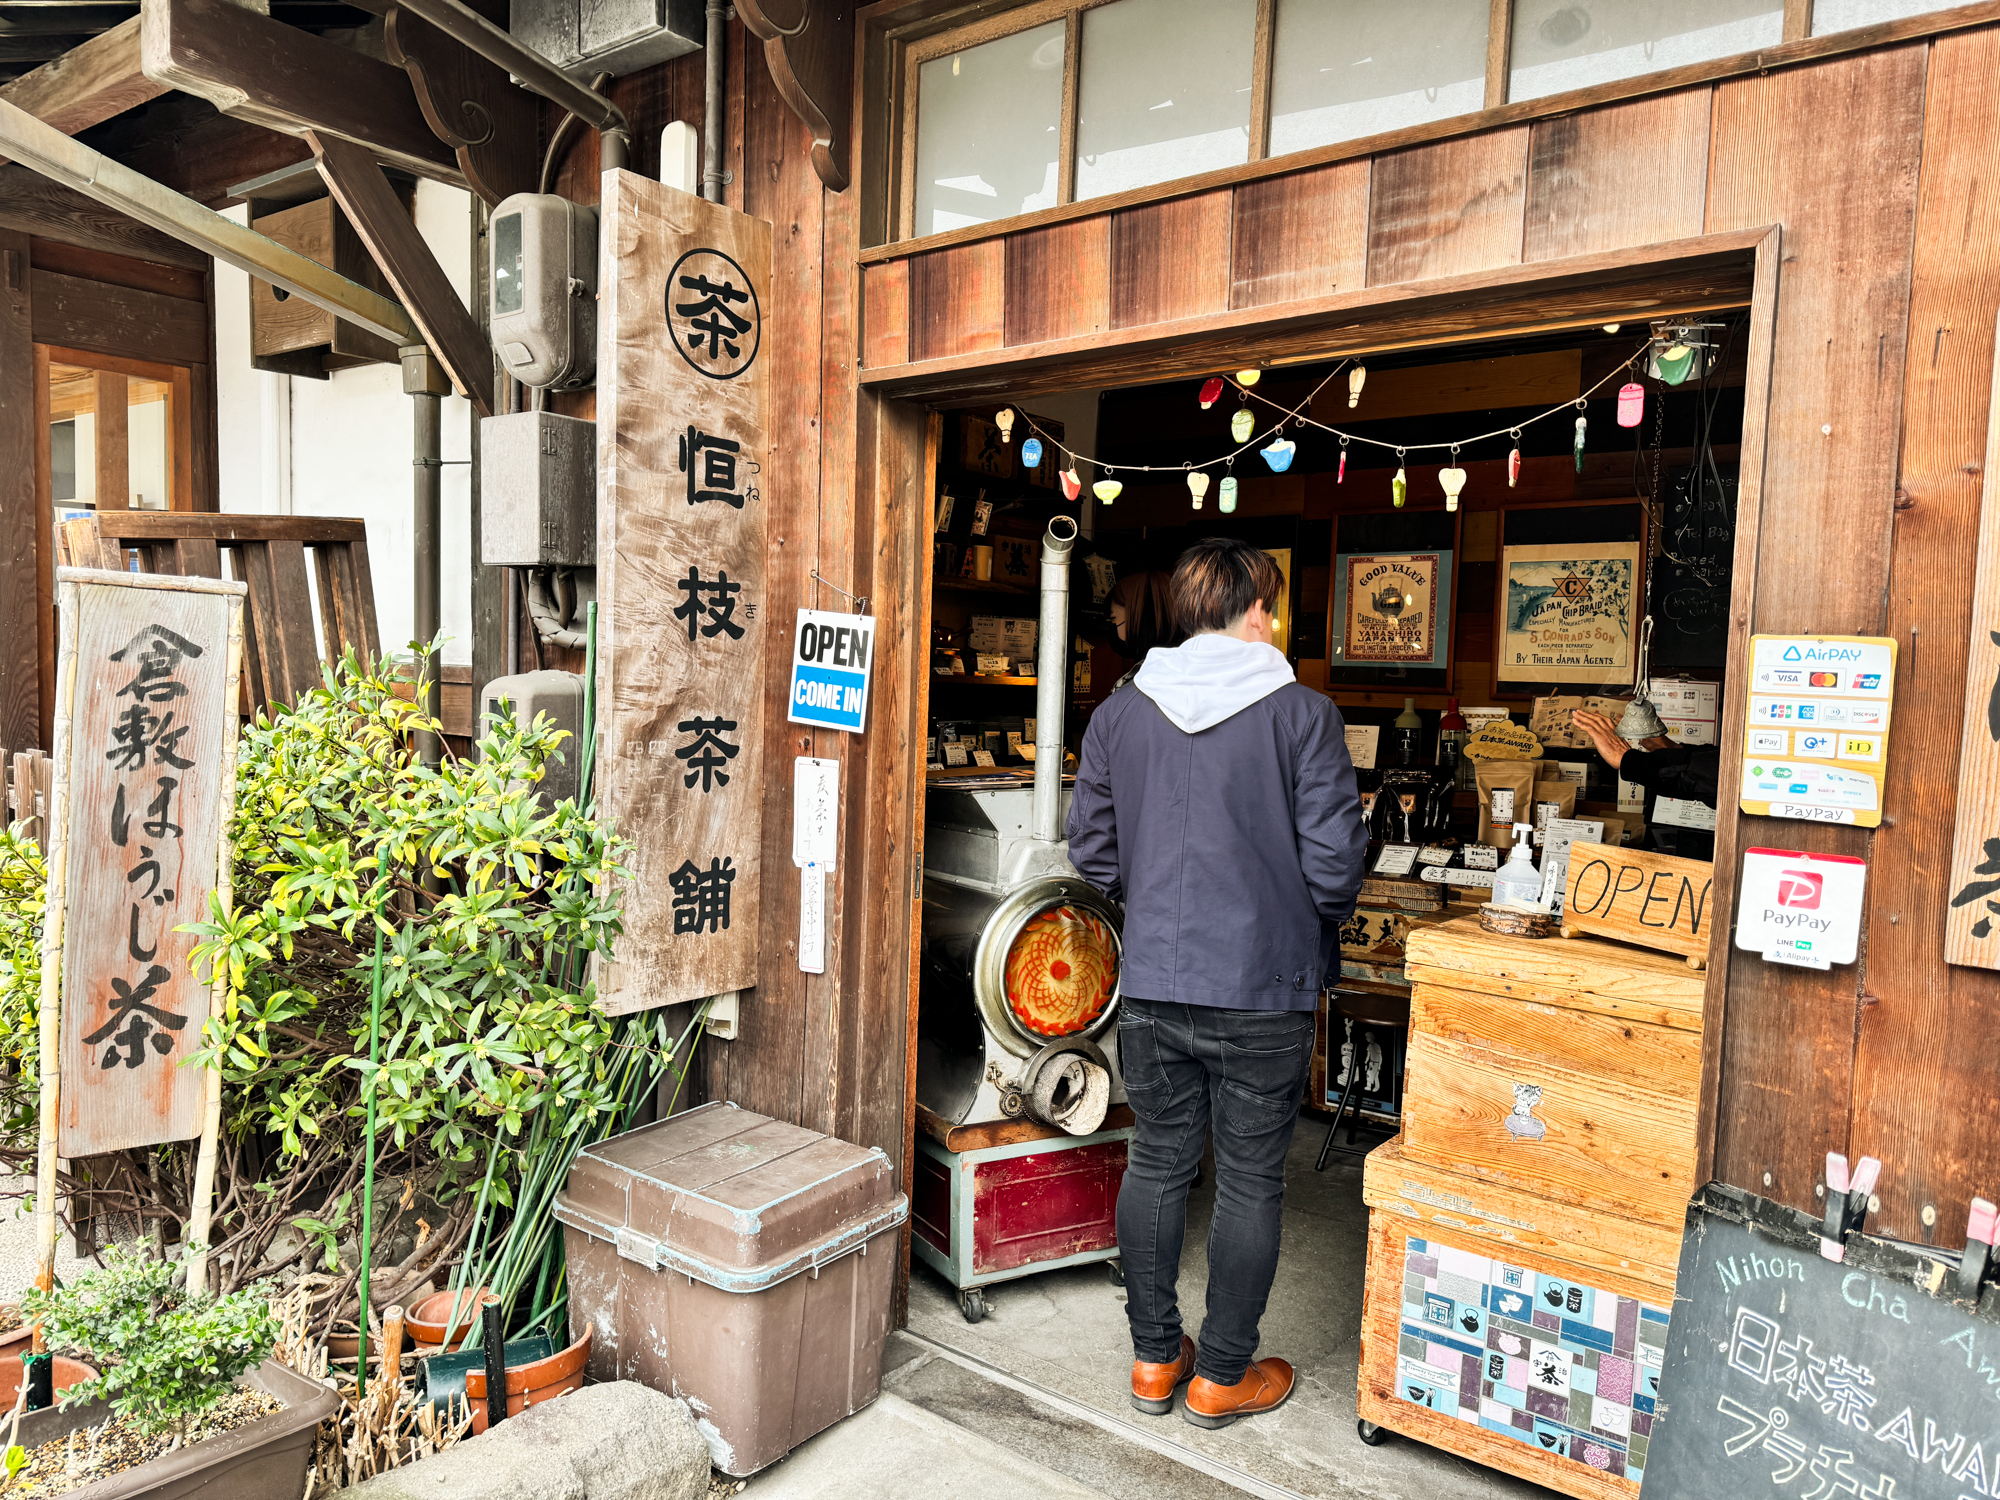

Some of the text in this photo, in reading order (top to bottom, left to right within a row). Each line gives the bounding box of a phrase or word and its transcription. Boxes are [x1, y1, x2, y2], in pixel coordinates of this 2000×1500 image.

[675, 273, 753, 360] 茶
[1024, 452, 1038, 460] TEA
[1359, 563, 1427, 587] GOOD VALUE
[1565, 580, 1577, 595] C
[1531, 601, 1562, 618] JAPAN
[1562, 601, 1603, 620] CHIP BRAID
[1357, 612, 1389, 624] CAREFULLY
[1528, 616, 1595, 627] ESPECIALLY MANUFACTURED
[1543, 629, 1591, 642] CONRAD'S
[799, 622, 870, 670] OPEN
[1532, 653, 1553, 664] THEIR
[1556, 653, 1580, 665] JAPAN
[1804, 648, 1862, 662] AirPAY
[668, 424, 746, 935] 恒枝茶舗
[1777, 674, 1799, 683] VISA
[794, 678, 863, 714] COME IN
[1770, 703, 1792, 719] JCB
[1764, 738, 1778, 747] Pay
[1848, 741, 1872, 753] iD
[1784, 805, 1844, 821] PayPay
[82, 623, 204, 1070] 倉敷ほうじ茶
[1572, 860, 1712, 935] OPEN
[1763, 909, 1832, 933] PayPay
[1776, 938, 1810, 950] LINE Pay
[1786, 952, 1811, 963] Alipay
[1715, 1252, 1805, 1294] Nihon
[1840, 1271, 1911, 1325] Cha
[1568, 1296, 1580, 1311] 茶
